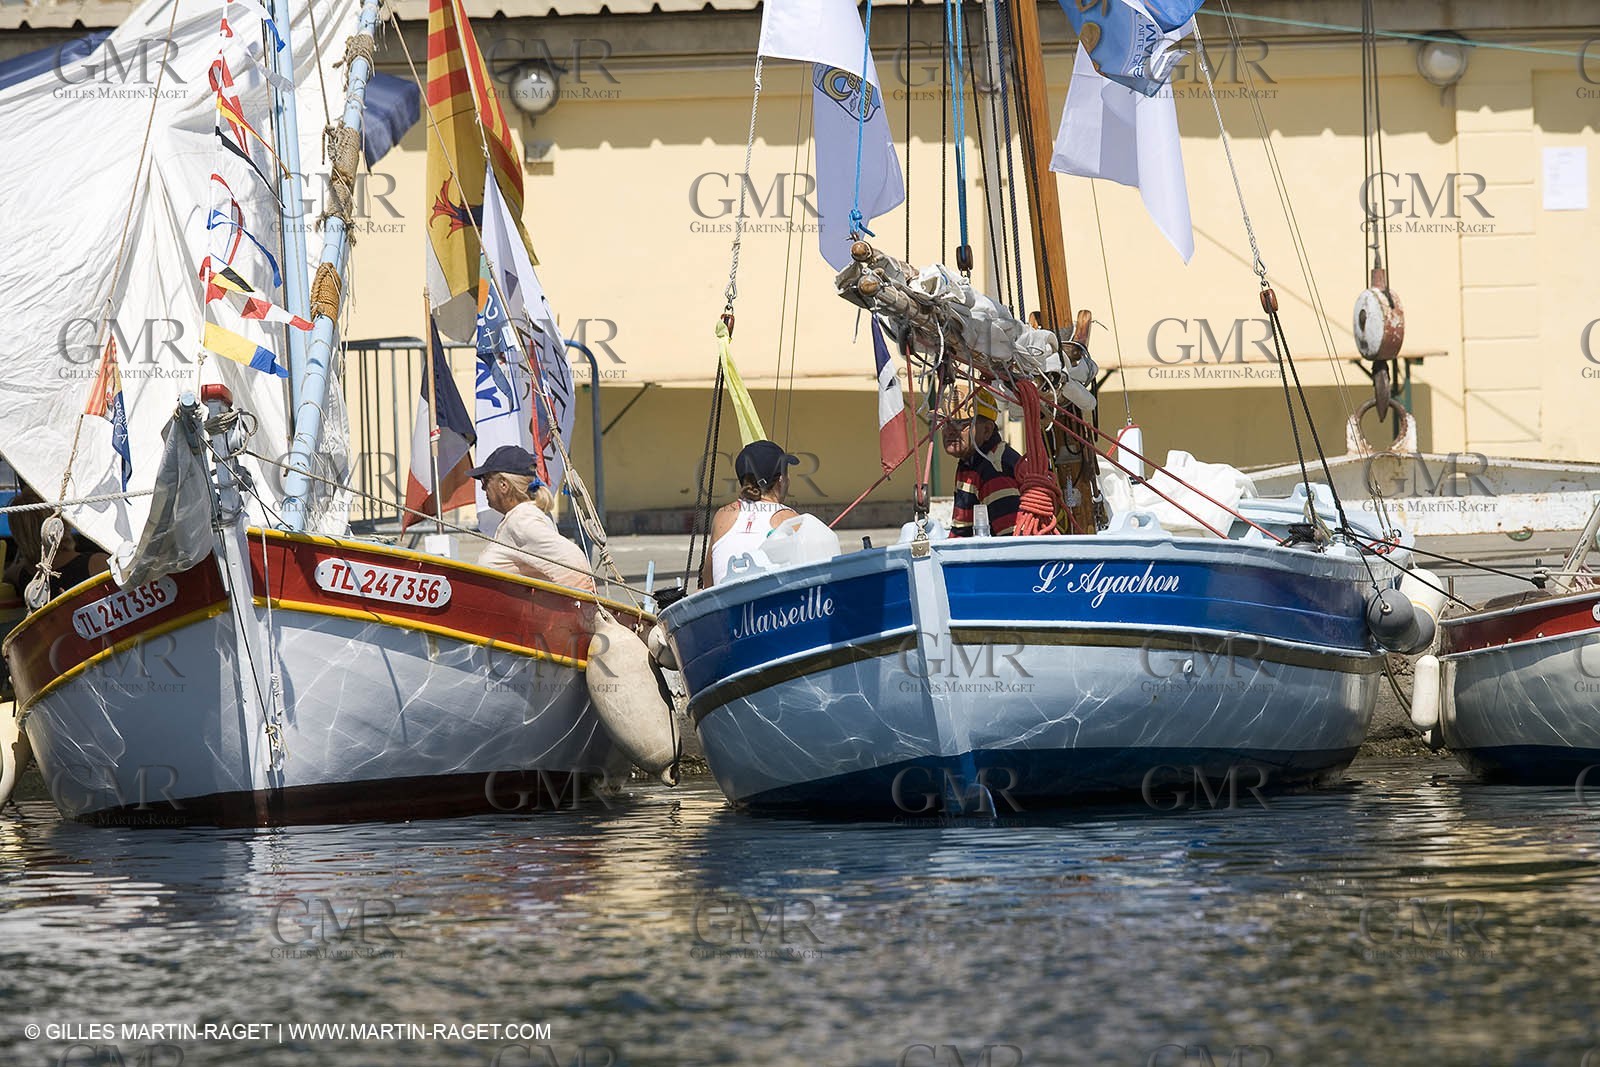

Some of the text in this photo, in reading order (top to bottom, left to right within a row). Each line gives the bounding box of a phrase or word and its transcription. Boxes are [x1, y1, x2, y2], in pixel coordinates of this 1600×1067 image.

[78, 580, 167, 636] TL 247356
[329, 564, 441, 604] TL 247356
[1032, 560, 1180, 609] L'Agachon
[733, 585, 835, 639] Marseille
